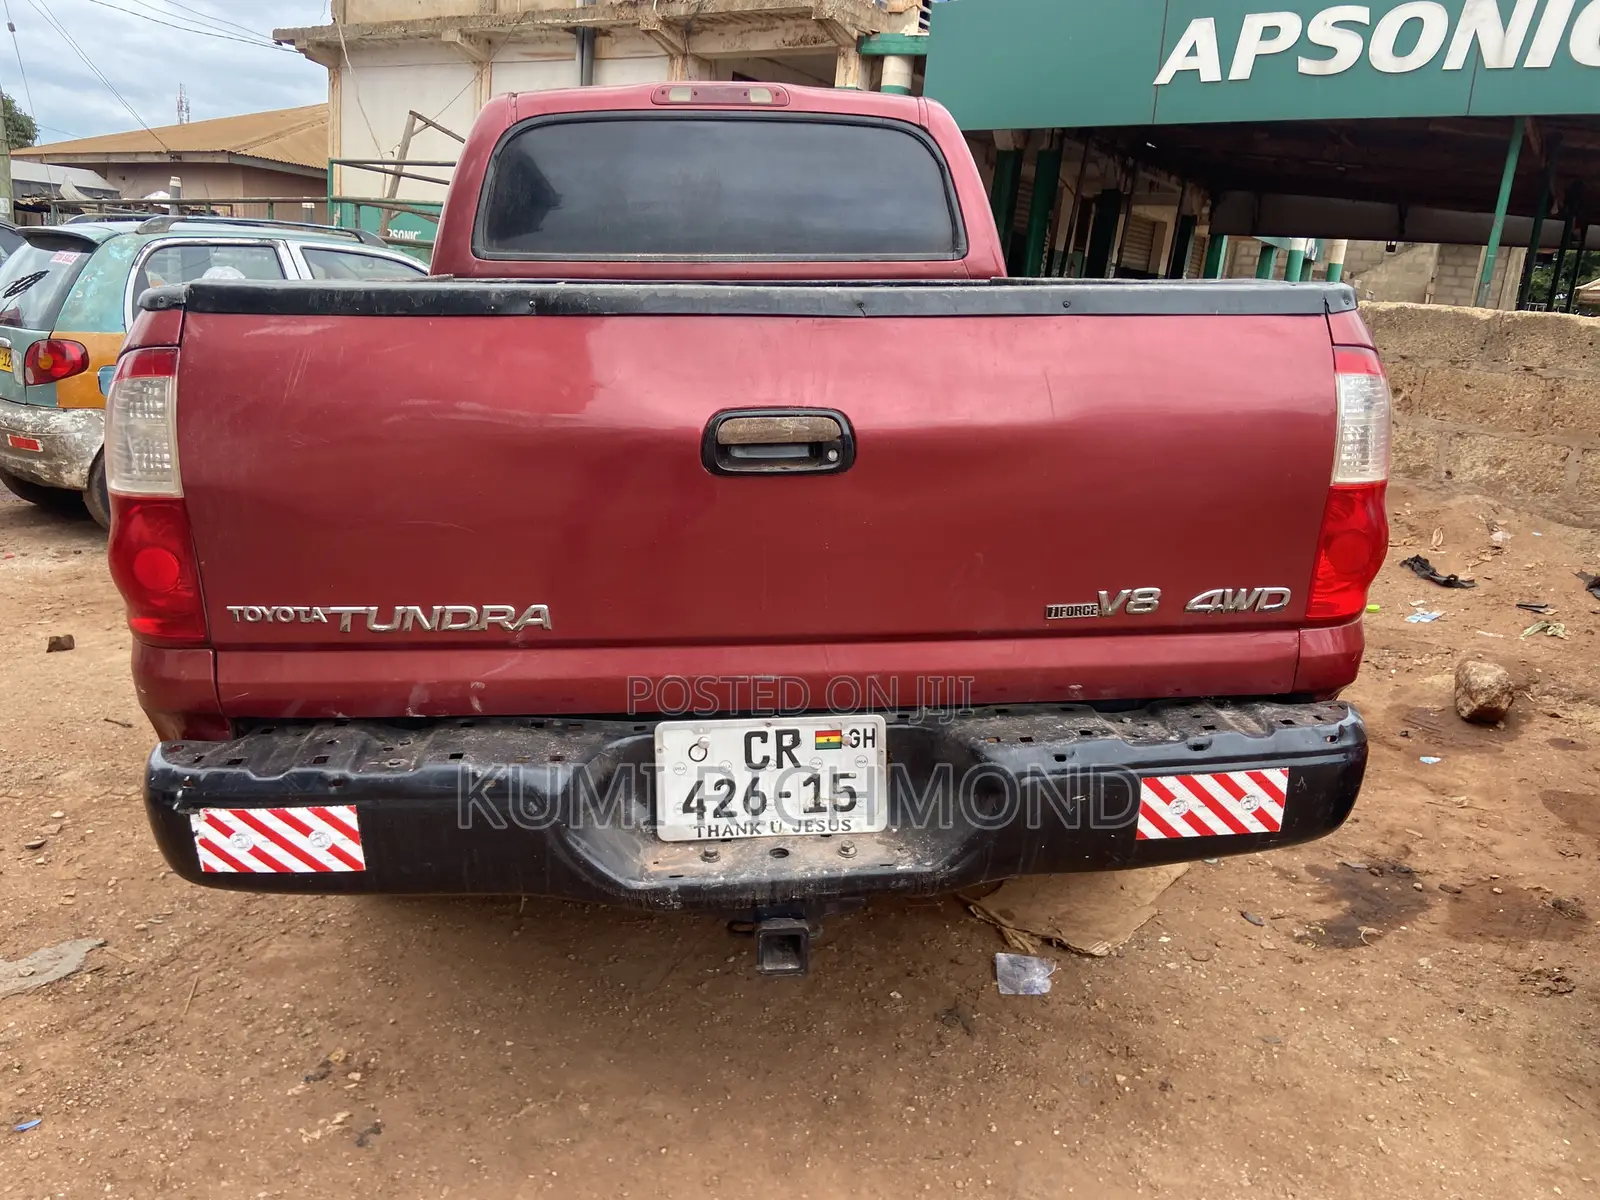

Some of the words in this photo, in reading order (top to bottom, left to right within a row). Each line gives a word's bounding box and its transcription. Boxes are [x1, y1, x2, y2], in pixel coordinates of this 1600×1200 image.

[1098, 587, 1161, 617] V8
[1184, 586, 1292, 615] 4WD
[226, 605, 329, 624] TOYOTA
[330, 604, 552, 632] TUNDRA
[744, 729, 802, 770] CR
[848, 728, 875, 749] GH
[693, 820, 762, 838] THANK
[770, 819, 782, 834] U
[791, 818, 852, 833] JESUS
